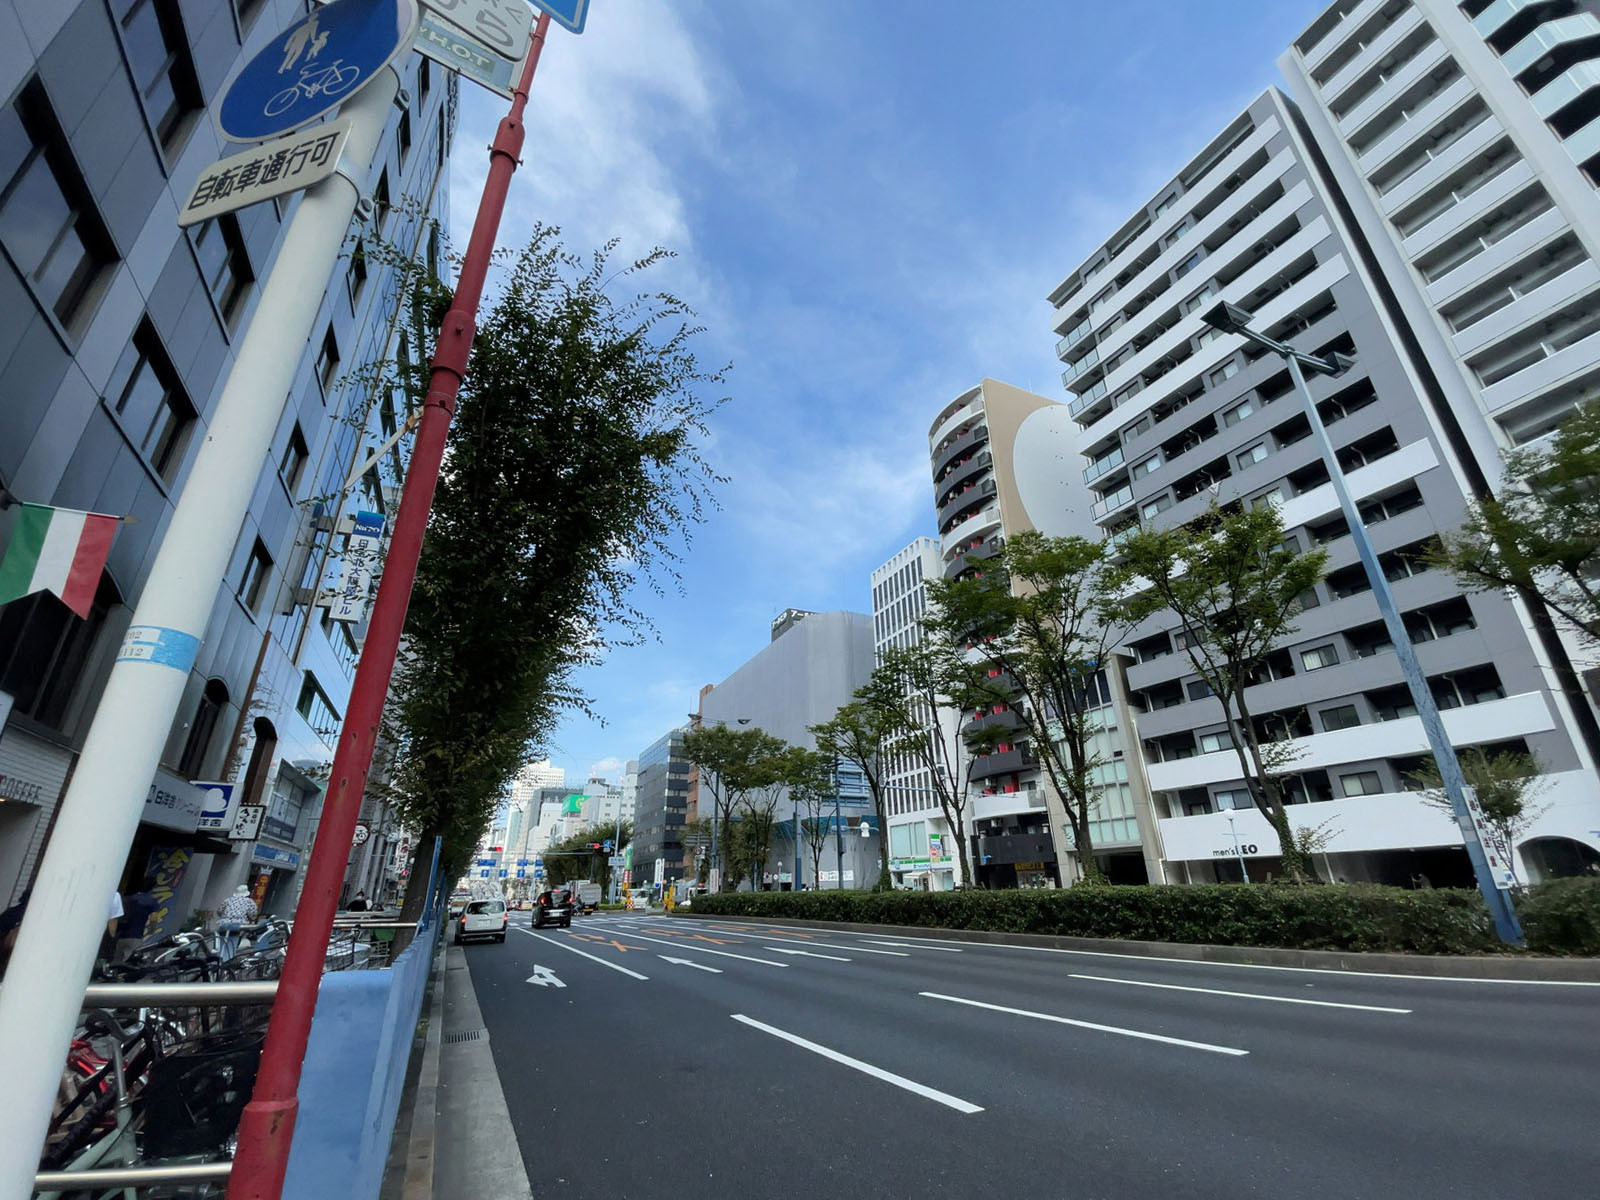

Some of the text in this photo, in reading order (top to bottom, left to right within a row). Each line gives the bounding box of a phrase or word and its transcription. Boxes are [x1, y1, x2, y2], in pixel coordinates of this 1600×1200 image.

[187, 131, 341, 211] 自転車通行可
[1212, 847, 1236, 856] men's
